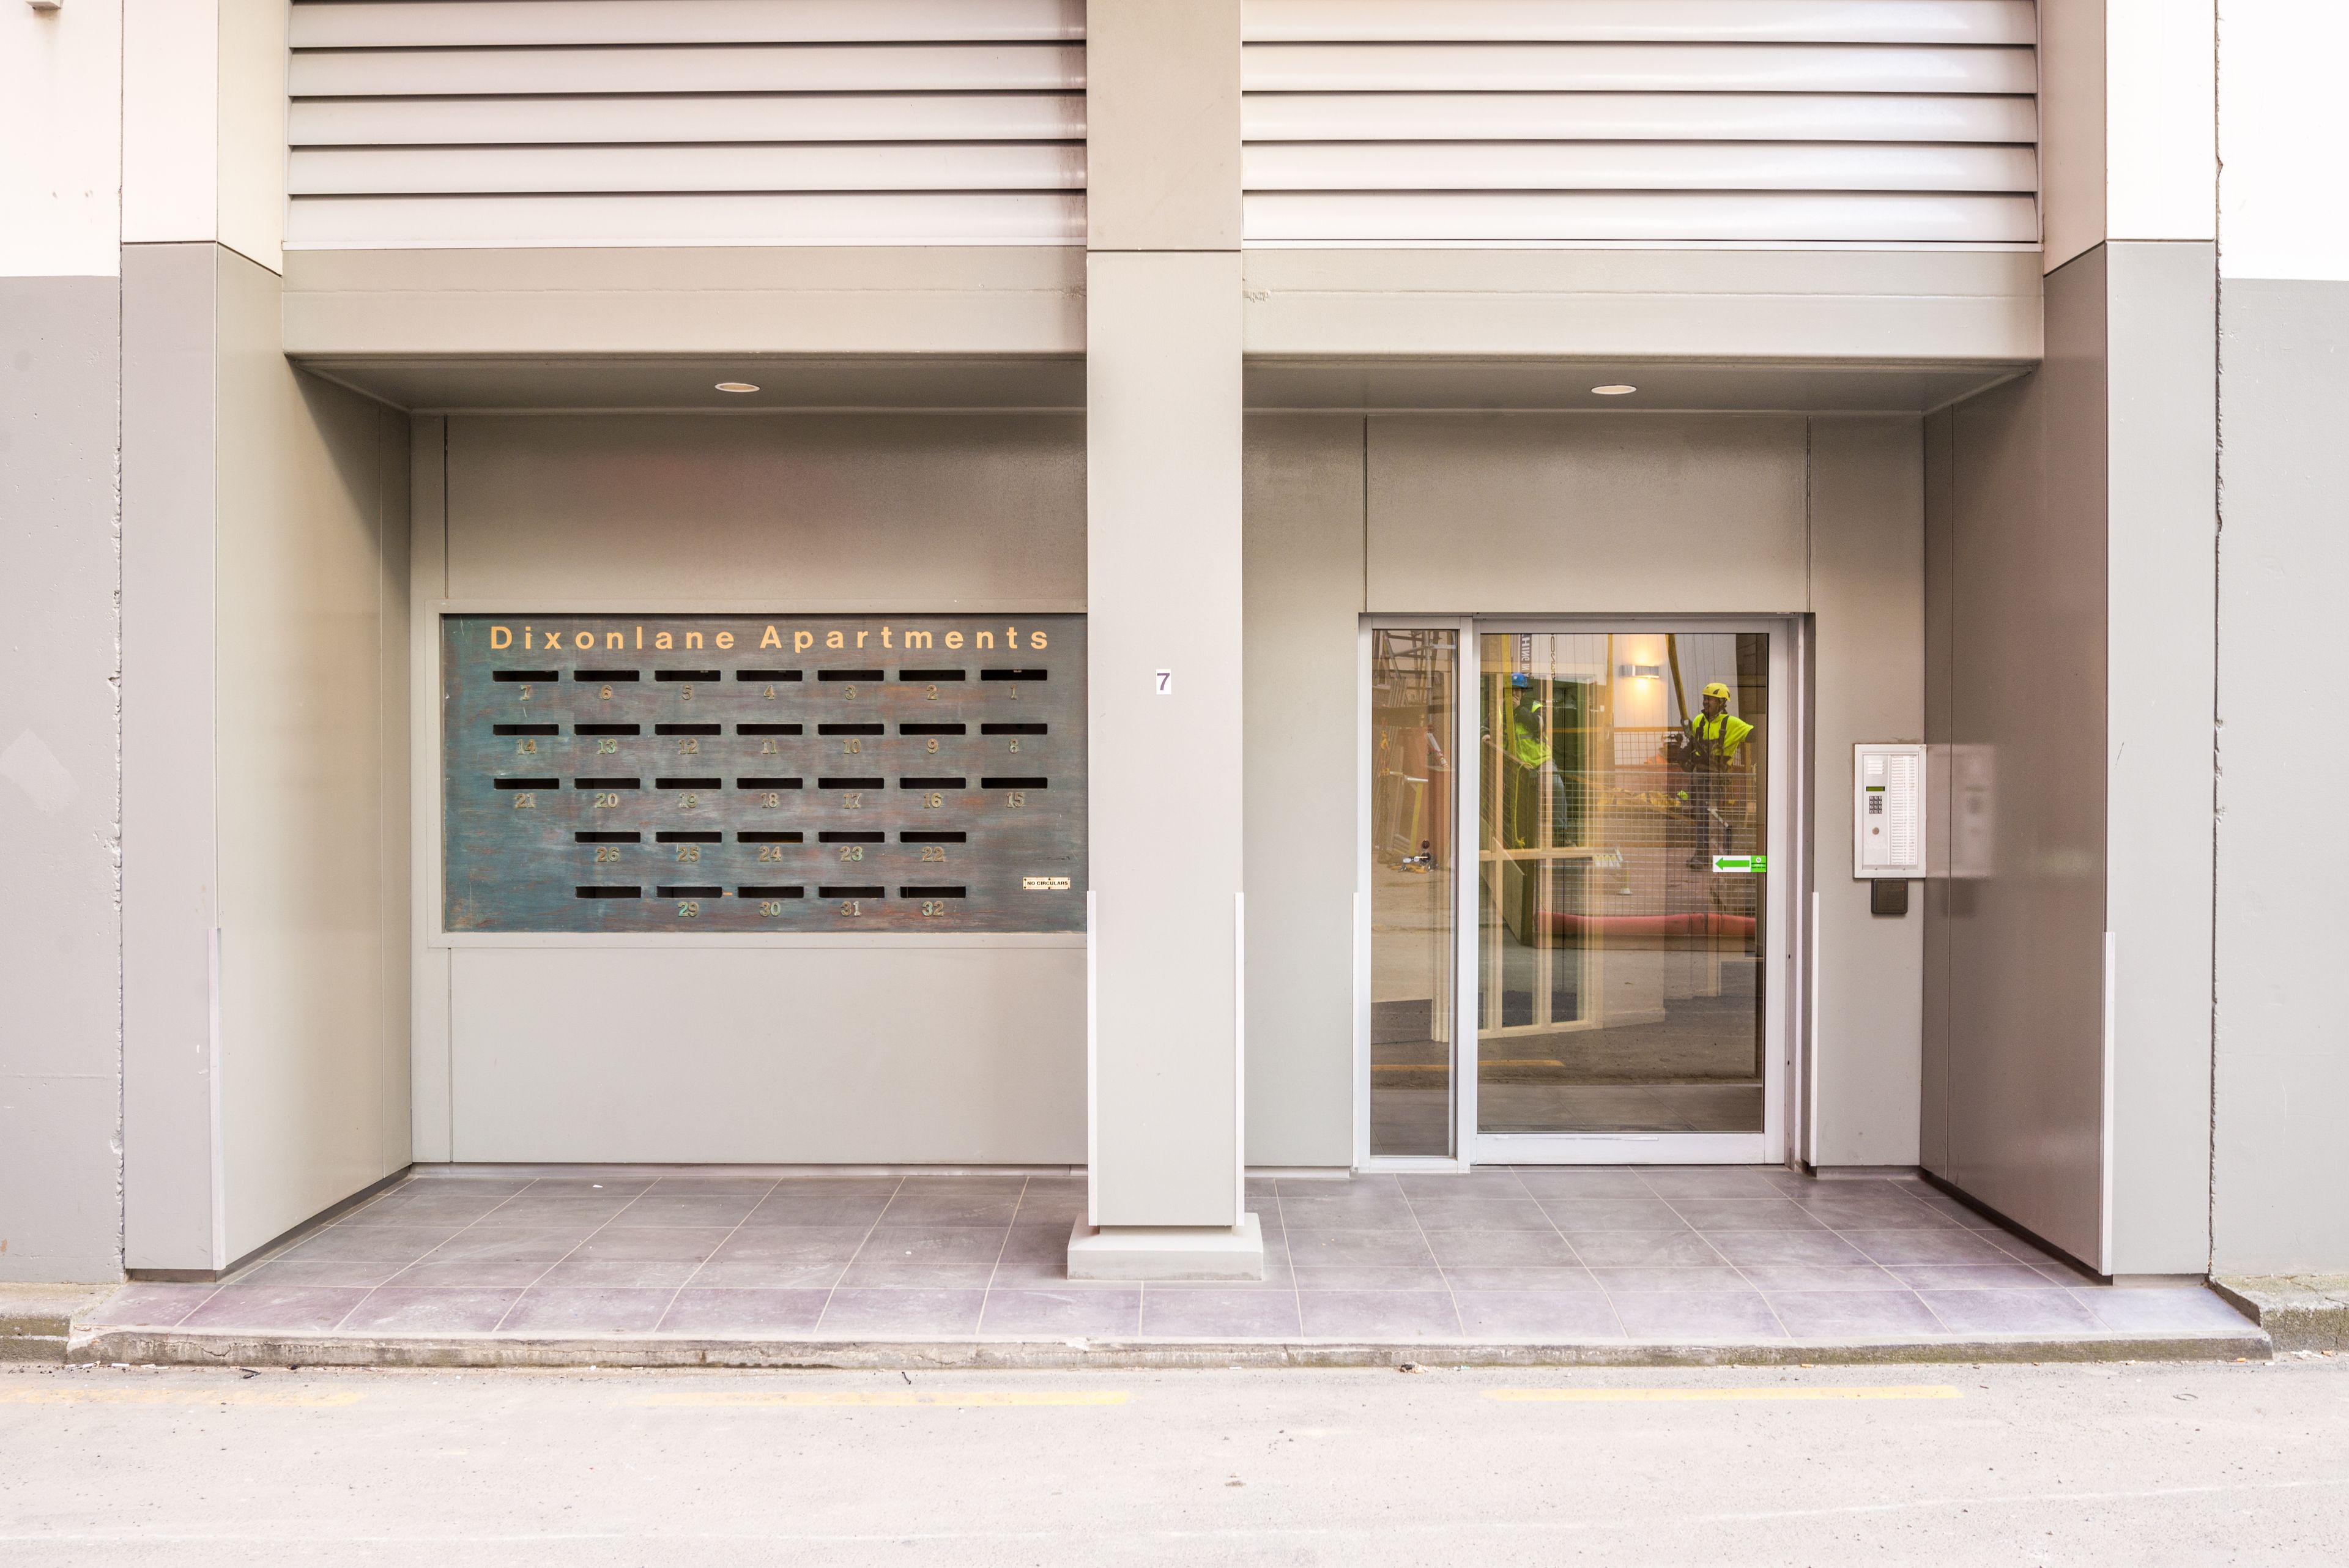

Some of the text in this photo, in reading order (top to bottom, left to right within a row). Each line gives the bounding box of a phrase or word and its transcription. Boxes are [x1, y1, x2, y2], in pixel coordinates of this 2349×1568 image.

[491, 626, 1047, 653] Dixonlane Apartments
[1157, 672, 1170, 691] 7
[520, 685, 531, 700] 7
[601, 685, 612, 700] 6
[681, 685, 692, 700] 5
[763, 685, 774, 699] 4
[845, 685, 856, 699] 3
[927, 685, 937, 699] 2
[1010, 685, 1017, 699] 1
[518, 739, 536, 754] 14
[598, 739, 617, 754] 13
[678, 739, 698, 754] 12
[761, 739, 777, 754] 11
[844, 739, 861, 754] 10
[927, 738, 938, 754] 9
[1009, 738, 1019, 754] 8
[515, 793, 534, 808] 21
[596, 793, 618, 808] 20
[679, 793, 699, 808] 19
[760, 793, 778, 808] 18
[843, 793, 861, 808] 17
[924, 792, 943, 808] 16
[1006, 792, 1024, 808] 15
[597, 847, 619, 862] 26
[678, 847, 699, 861] 25
[759, 847, 781, 861] 24
[840, 847, 863, 861] 23
[922, 846, 944, 861] 22
[678, 902, 699, 917] 29
[760, 902, 781, 916] 30
[841, 901, 861, 916] 31
[922, 901, 943, 916] 32
